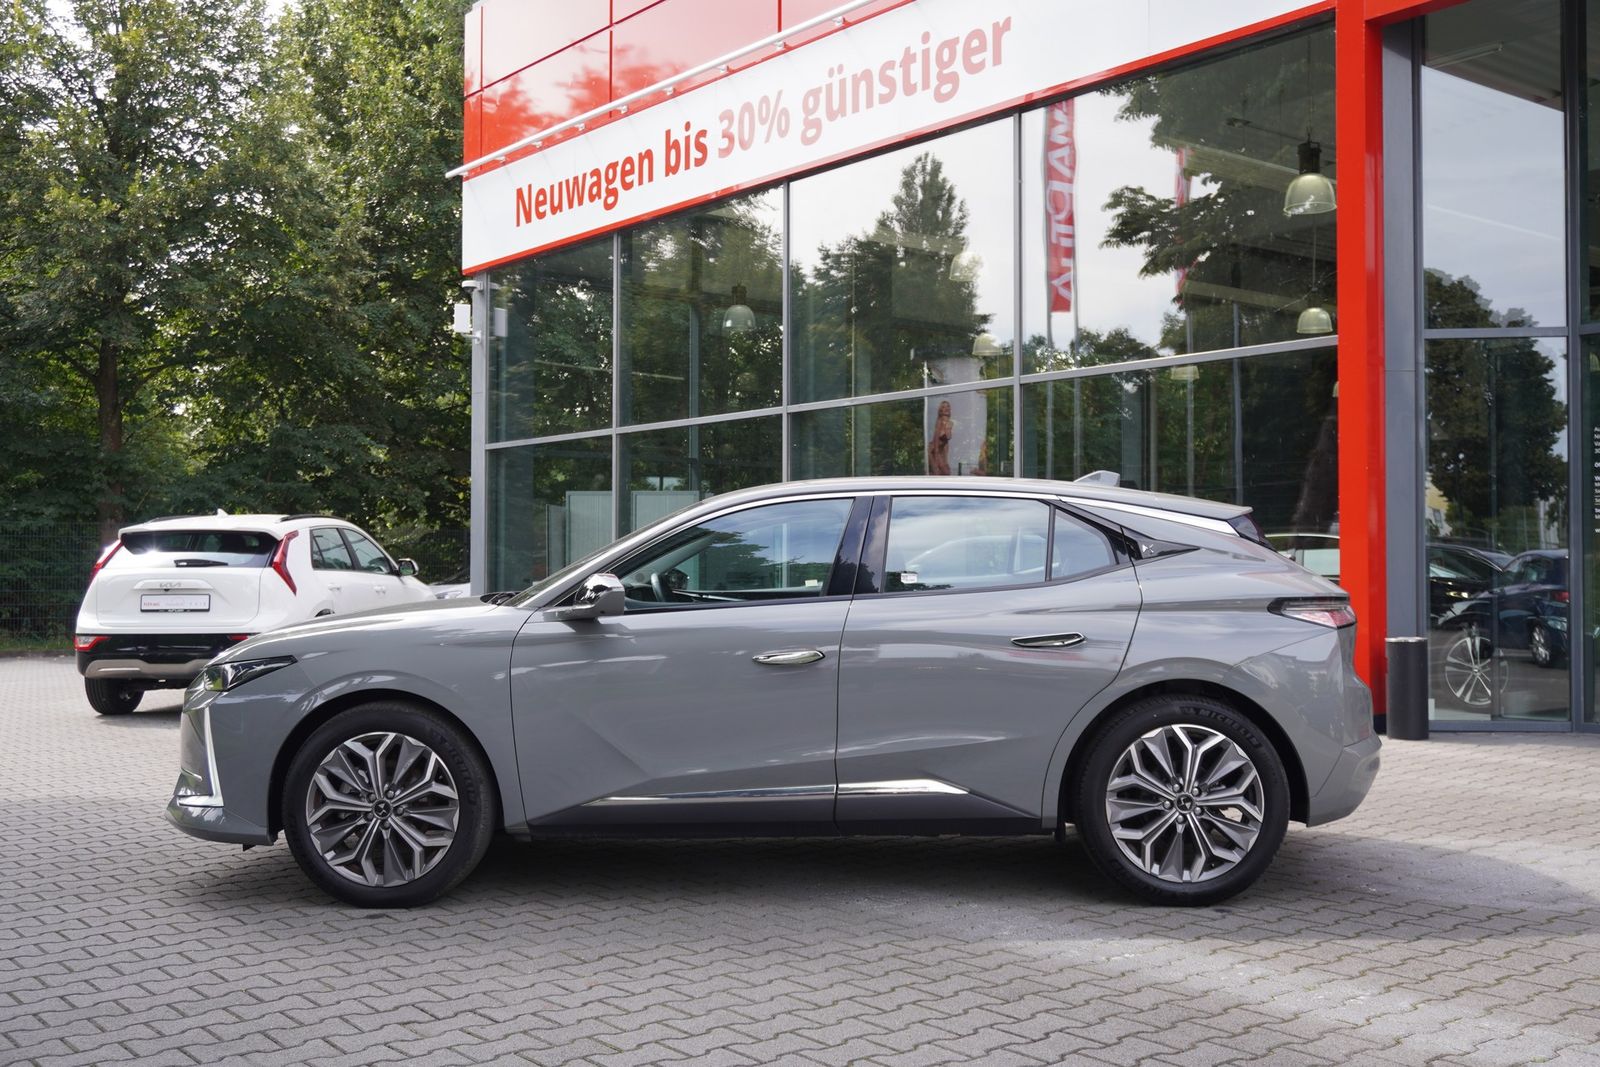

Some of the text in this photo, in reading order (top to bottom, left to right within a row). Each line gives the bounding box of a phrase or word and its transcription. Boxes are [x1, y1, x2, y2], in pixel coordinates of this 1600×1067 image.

[515, 16, 1012, 228] Neuwagen bis 30% günstiger
